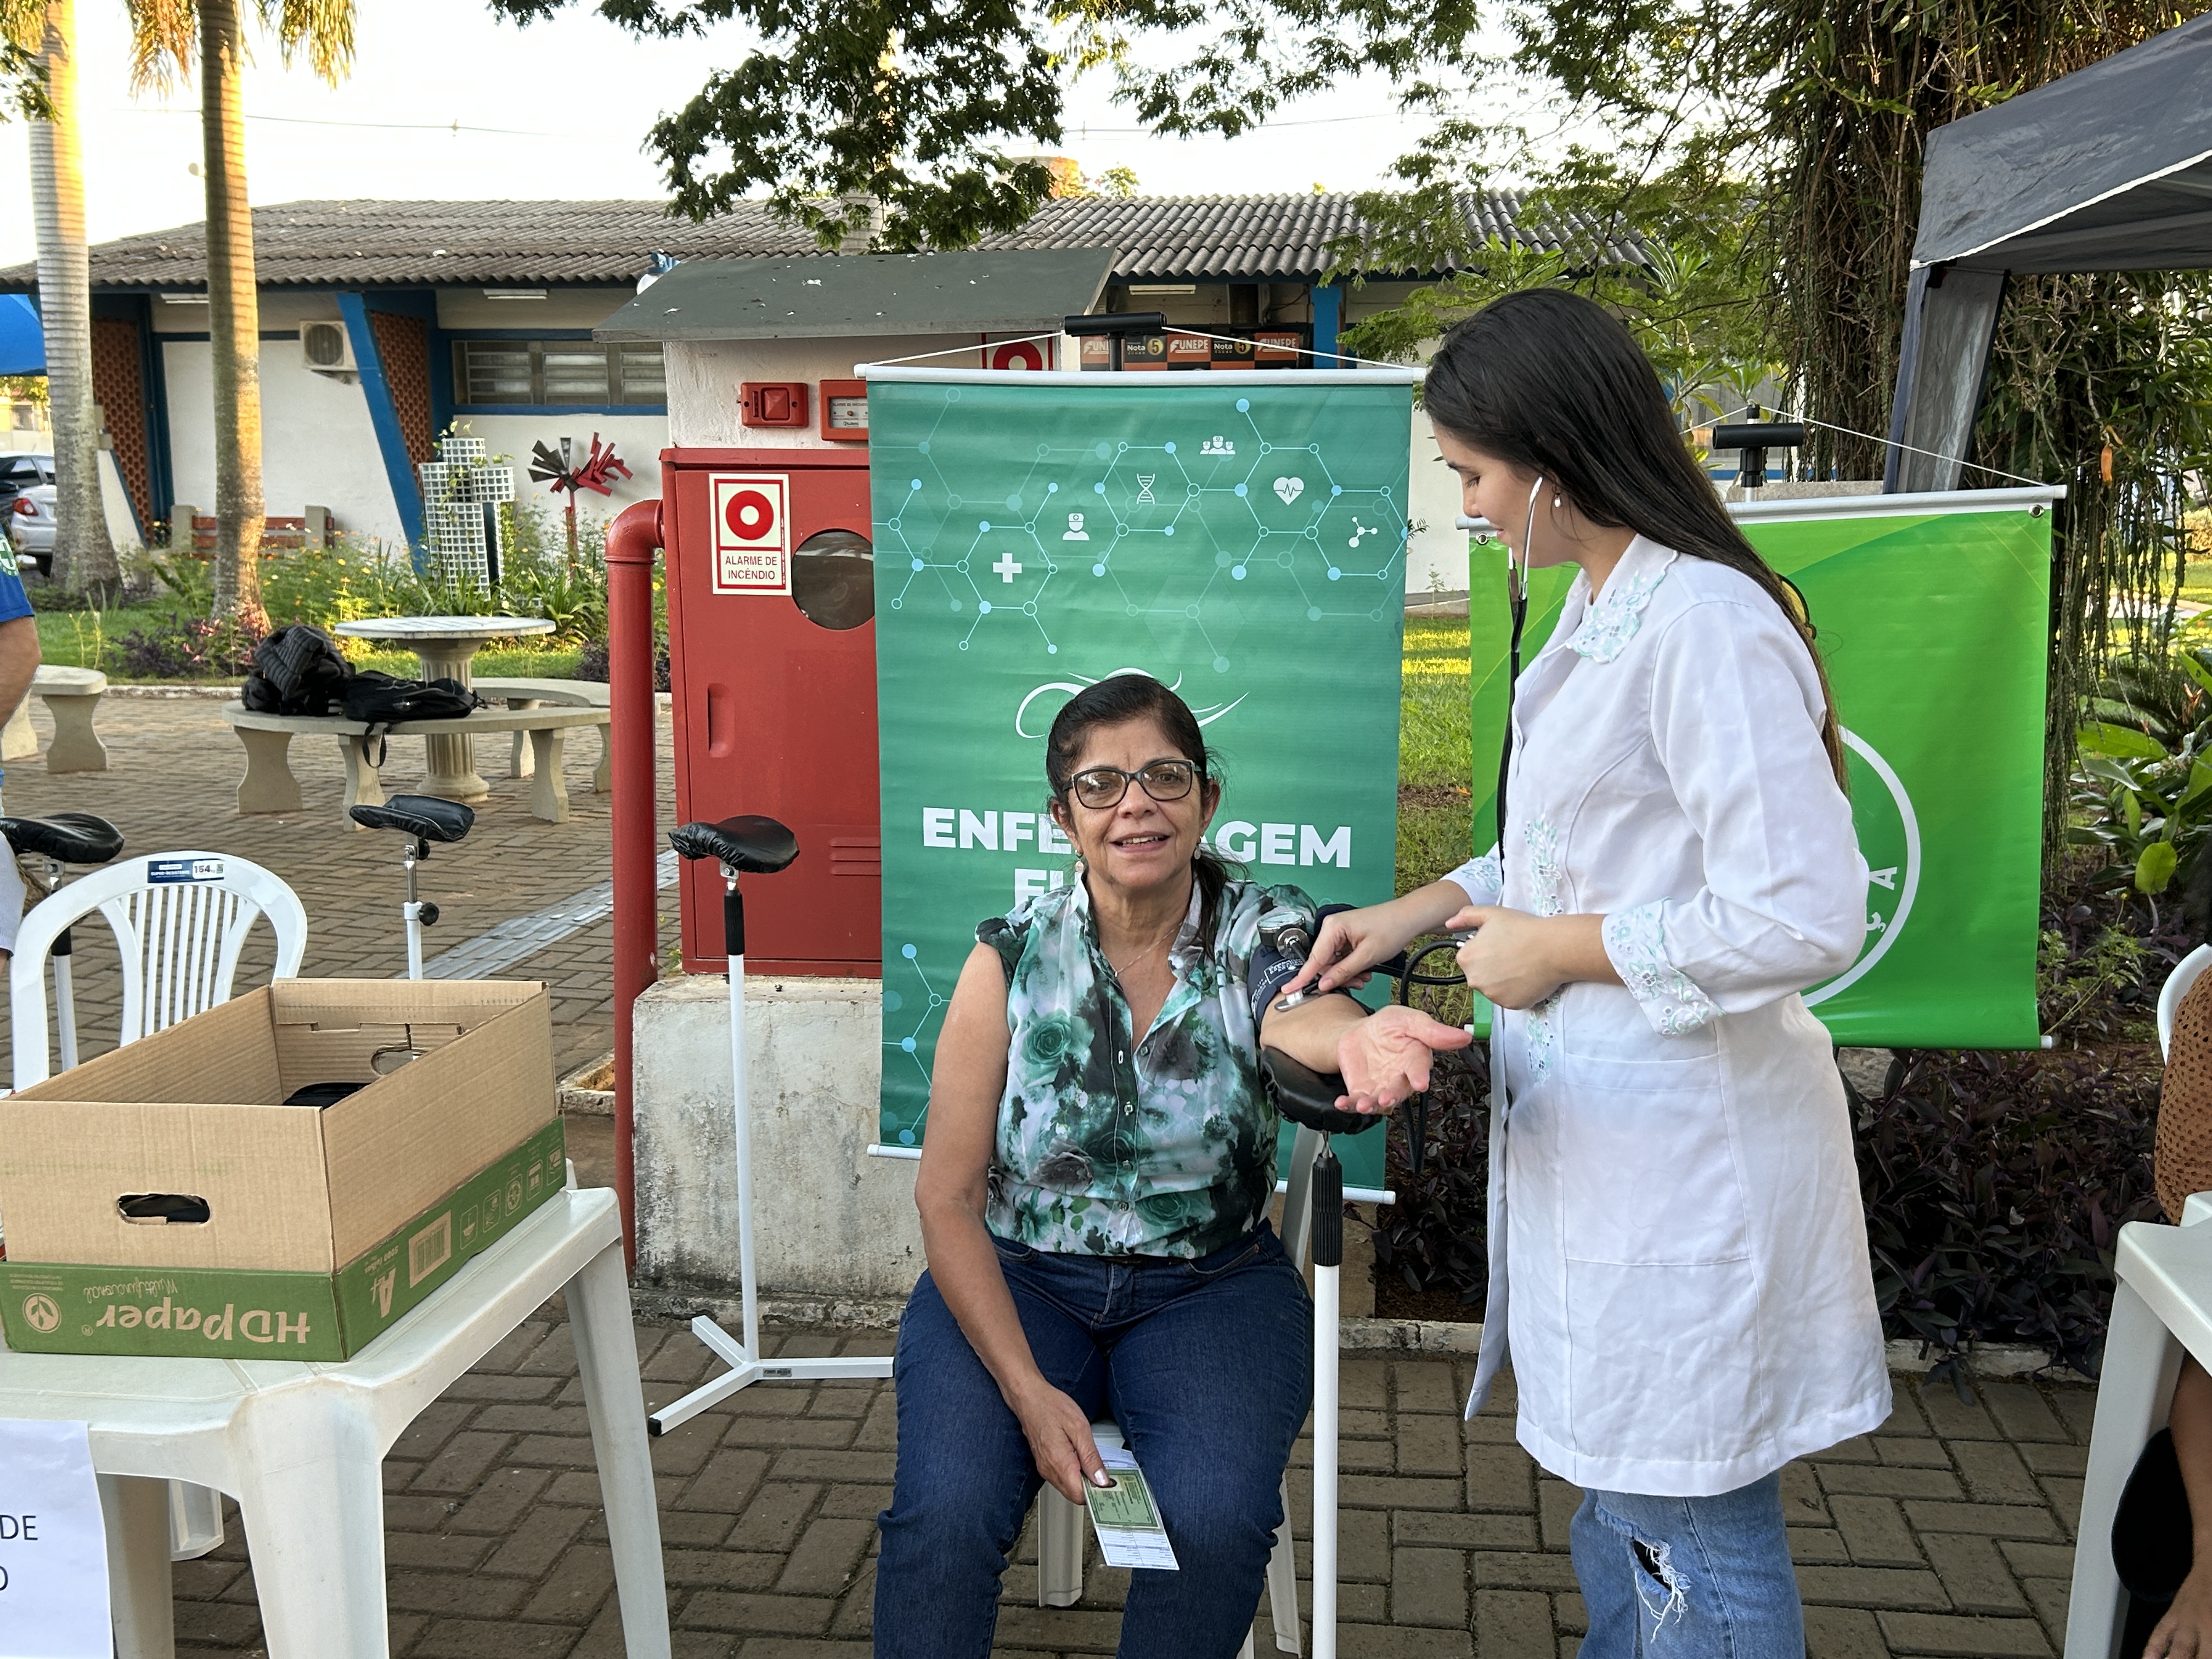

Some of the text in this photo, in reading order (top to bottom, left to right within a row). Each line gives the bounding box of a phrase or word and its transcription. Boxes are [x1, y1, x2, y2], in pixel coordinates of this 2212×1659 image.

[1152, 340, 1159, 353] 5
[1170, 339, 1209, 353] FUNEPE
[725, 555, 778, 566] ALARME DE
[728, 567, 775, 580] INCÊNDIO
[83, 1276, 178, 1304] Multifuncional
